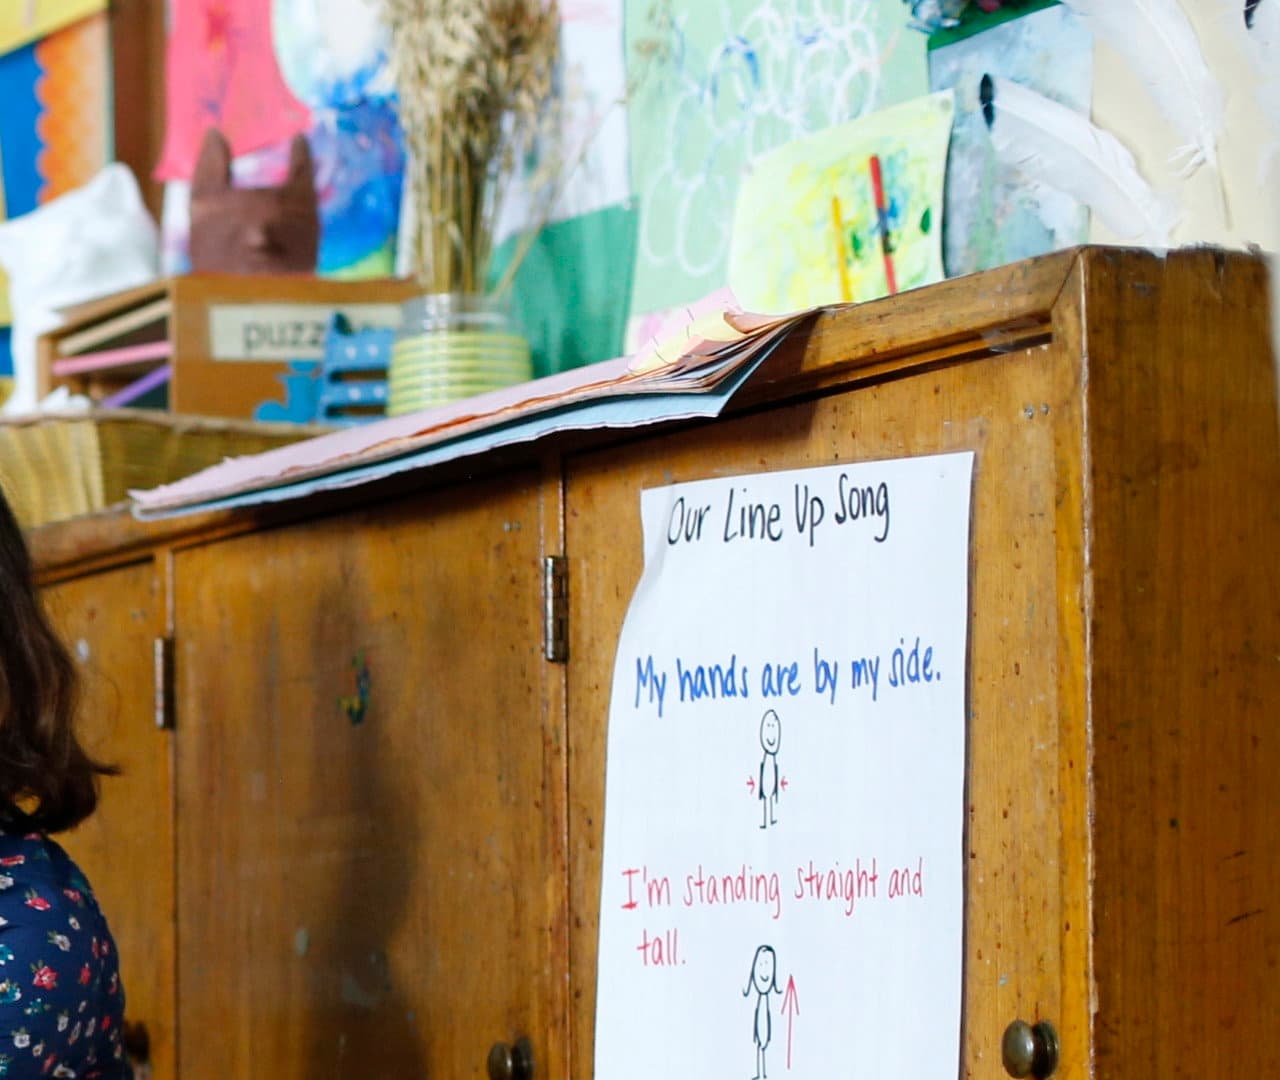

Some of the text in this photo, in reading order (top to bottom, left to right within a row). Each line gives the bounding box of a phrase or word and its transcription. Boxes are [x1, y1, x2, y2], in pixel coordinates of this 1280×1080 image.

[667, 473, 890, 548] Our Line Up Song
[634, 636, 941, 719] My hands are by my side.
[621, 857, 923, 919] I'm standing straight and
[637, 928, 686, 967] tall.
